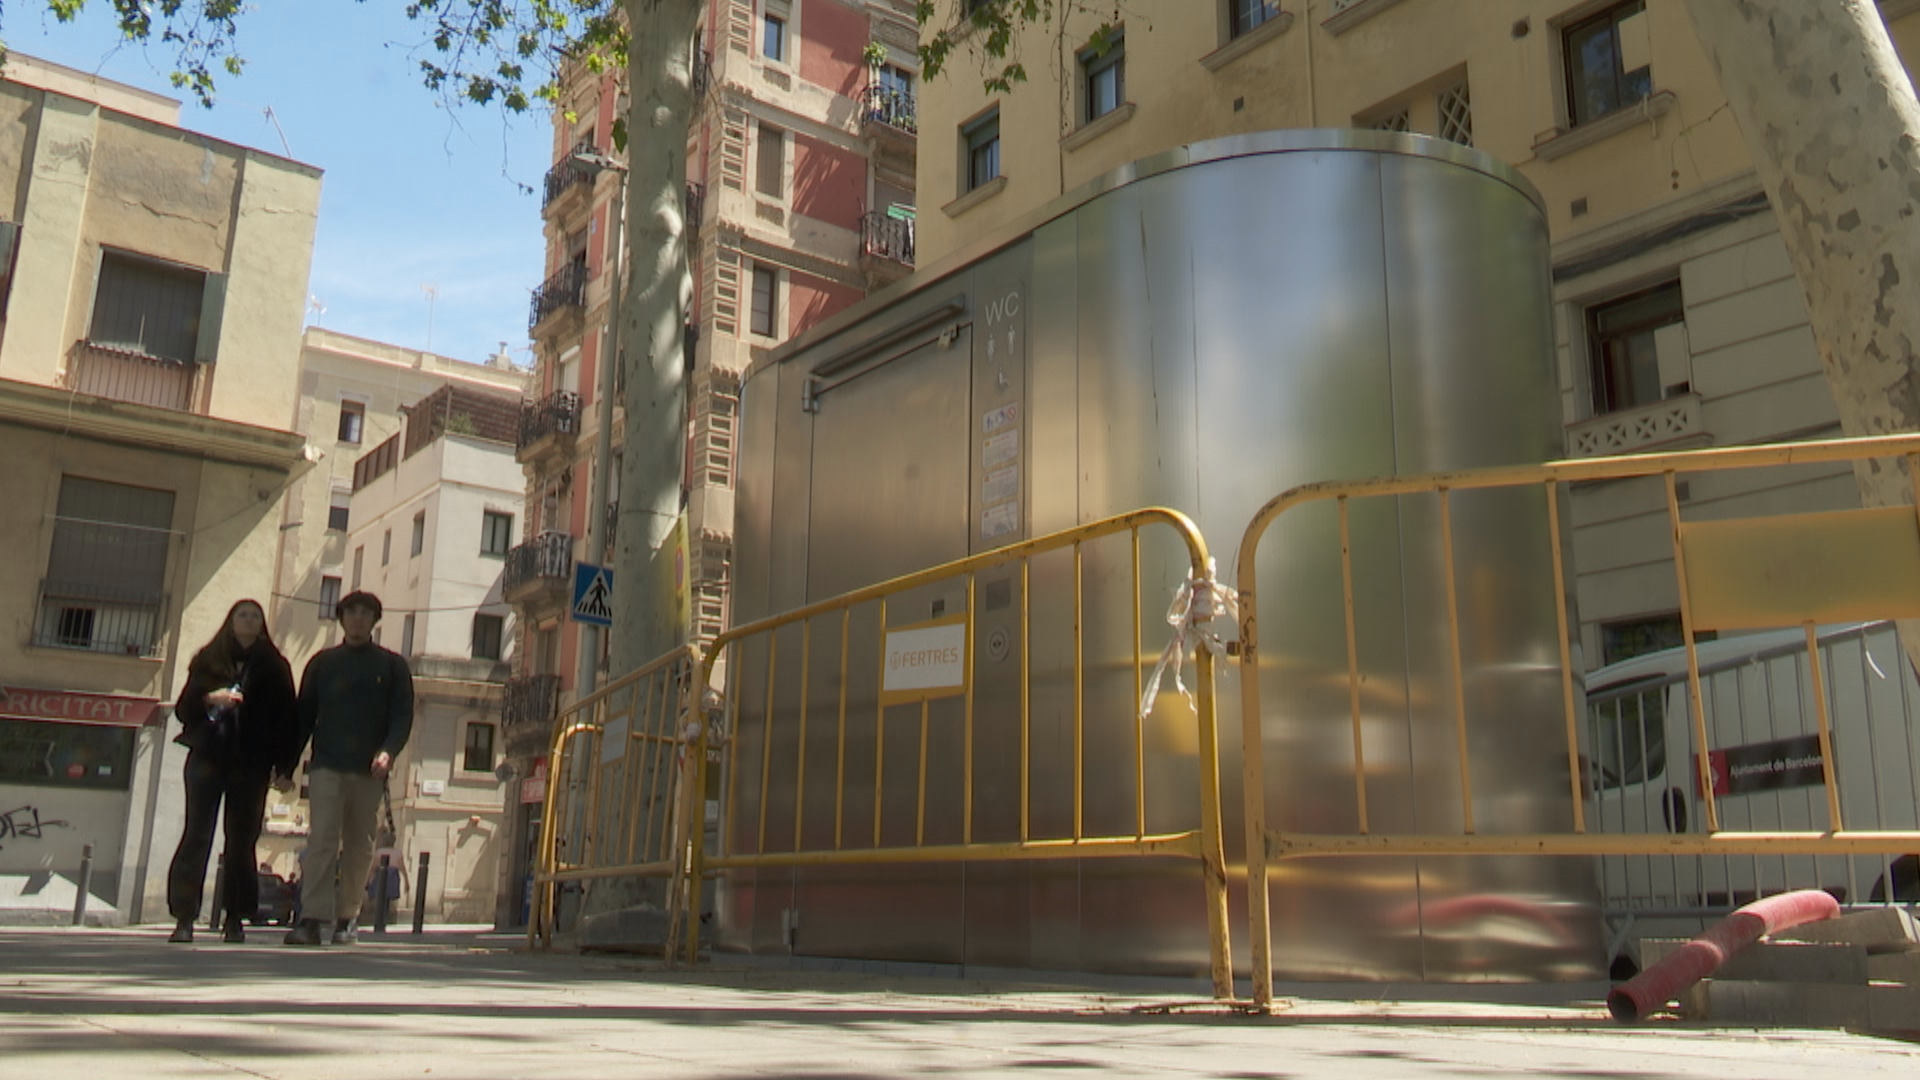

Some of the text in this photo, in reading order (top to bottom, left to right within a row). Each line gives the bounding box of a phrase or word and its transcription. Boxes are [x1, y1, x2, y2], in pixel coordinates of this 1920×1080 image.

[985, 291, 1019, 326] WC
[902, 647, 959, 668] FERTRES
[1730, 754, 1823, 779] Ajuntament de Barcelon
